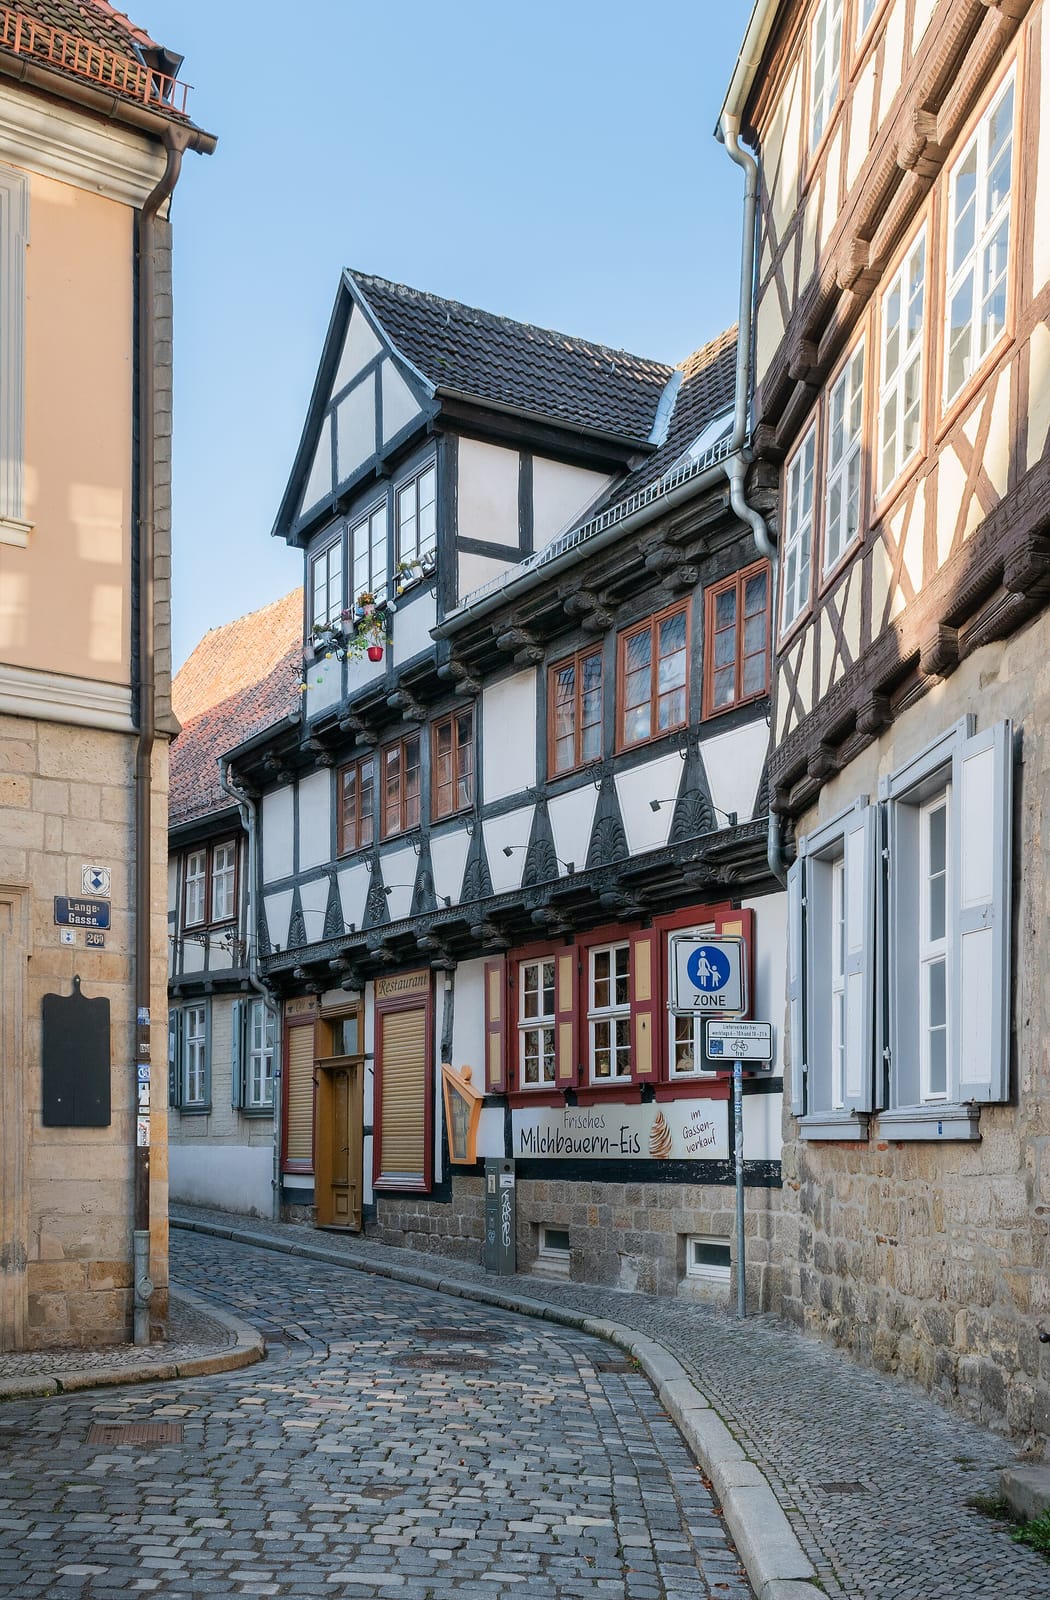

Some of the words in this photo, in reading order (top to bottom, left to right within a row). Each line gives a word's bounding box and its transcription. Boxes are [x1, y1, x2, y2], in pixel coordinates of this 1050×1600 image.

[68, 913, 99, 925] Gasse.
[378, 974, 427, 995] Restaurant
[693, 995, 726, 1006] ZONE
[564, 1111, 605, 1129] Frisches
[690, 1110, 701, 1121] im
[682, 1120, 714, 1139] Gassen-
[520, 1126, 641, 1154] Milchbauern-Eis
[686, 1129, 716, 1153] verkauf
